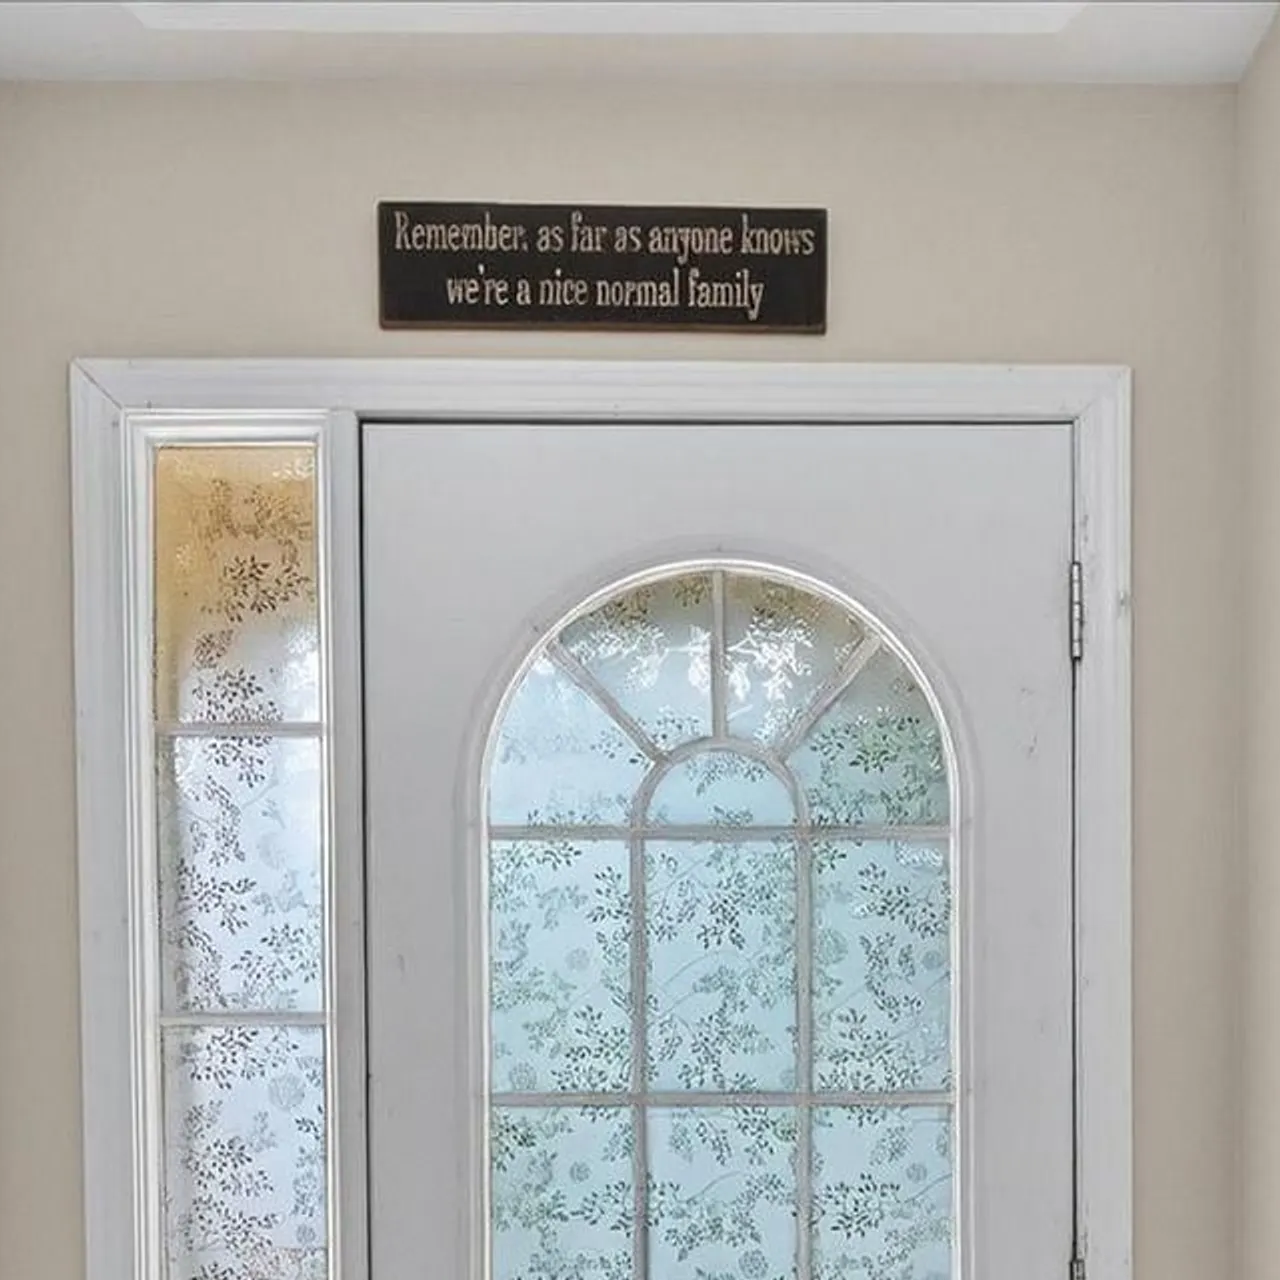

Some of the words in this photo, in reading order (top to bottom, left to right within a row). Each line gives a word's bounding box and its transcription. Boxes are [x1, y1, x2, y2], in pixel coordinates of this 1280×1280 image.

[536, 225, 565, 252] as
[571, 210, 607, 252] far
[614, 226, 642, 253] as
[649, 226, 734, 264] anyone
[741, 213, 815, 255] knows
[446, 263, 509, 305] we're
[516, 279, 531, 305] a
[539, 268, 588, 306] nice
[596, 267, 680, 307] normal
[688, 268, 764, 321] family
